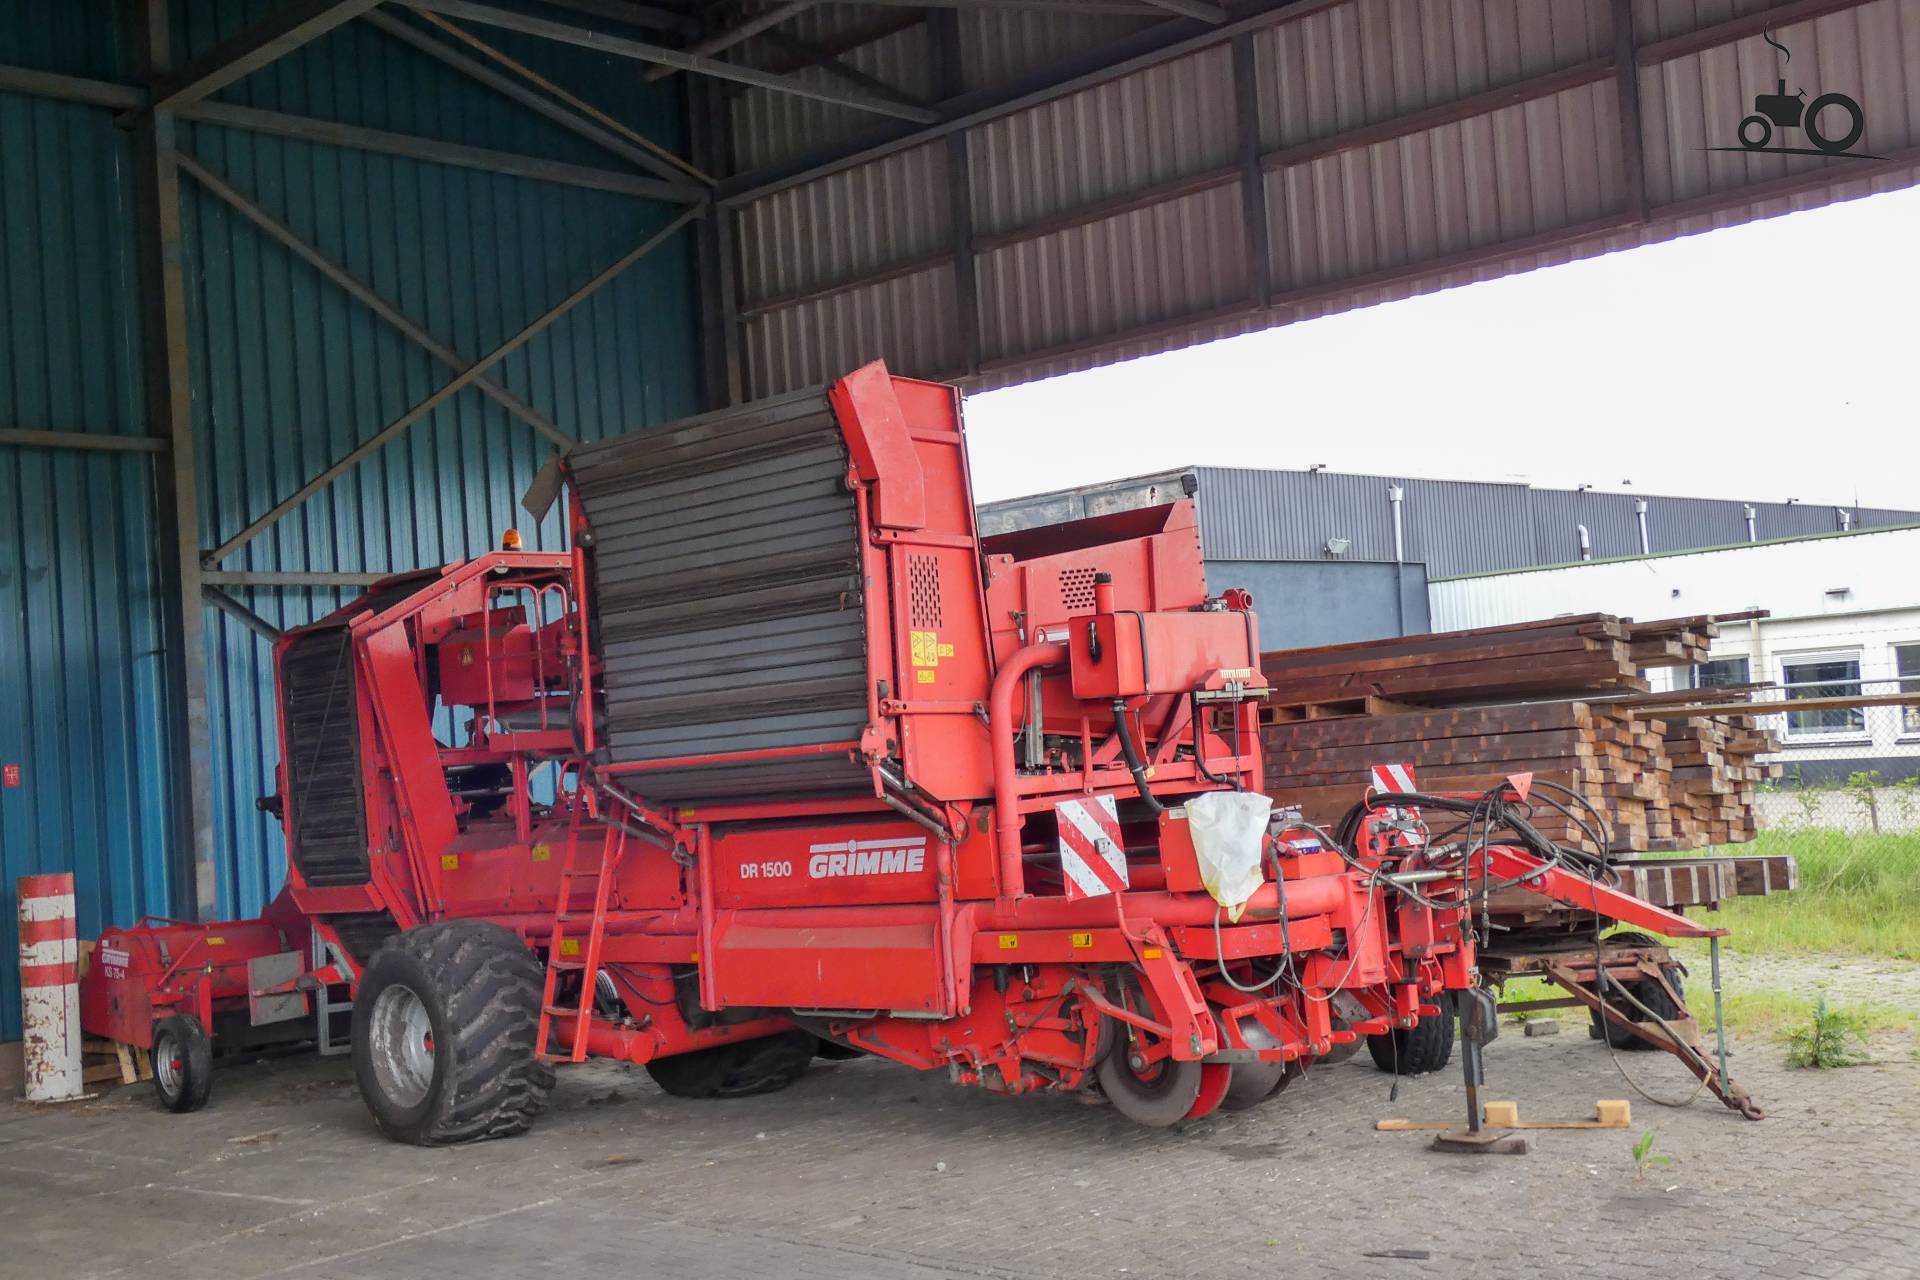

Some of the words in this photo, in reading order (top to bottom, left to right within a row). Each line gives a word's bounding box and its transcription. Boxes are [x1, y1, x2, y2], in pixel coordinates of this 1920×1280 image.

[741, 863, 758, 879] DR
[761, 861, 792, 878] 1500
[809, 845, 925, 879] GRIMME
